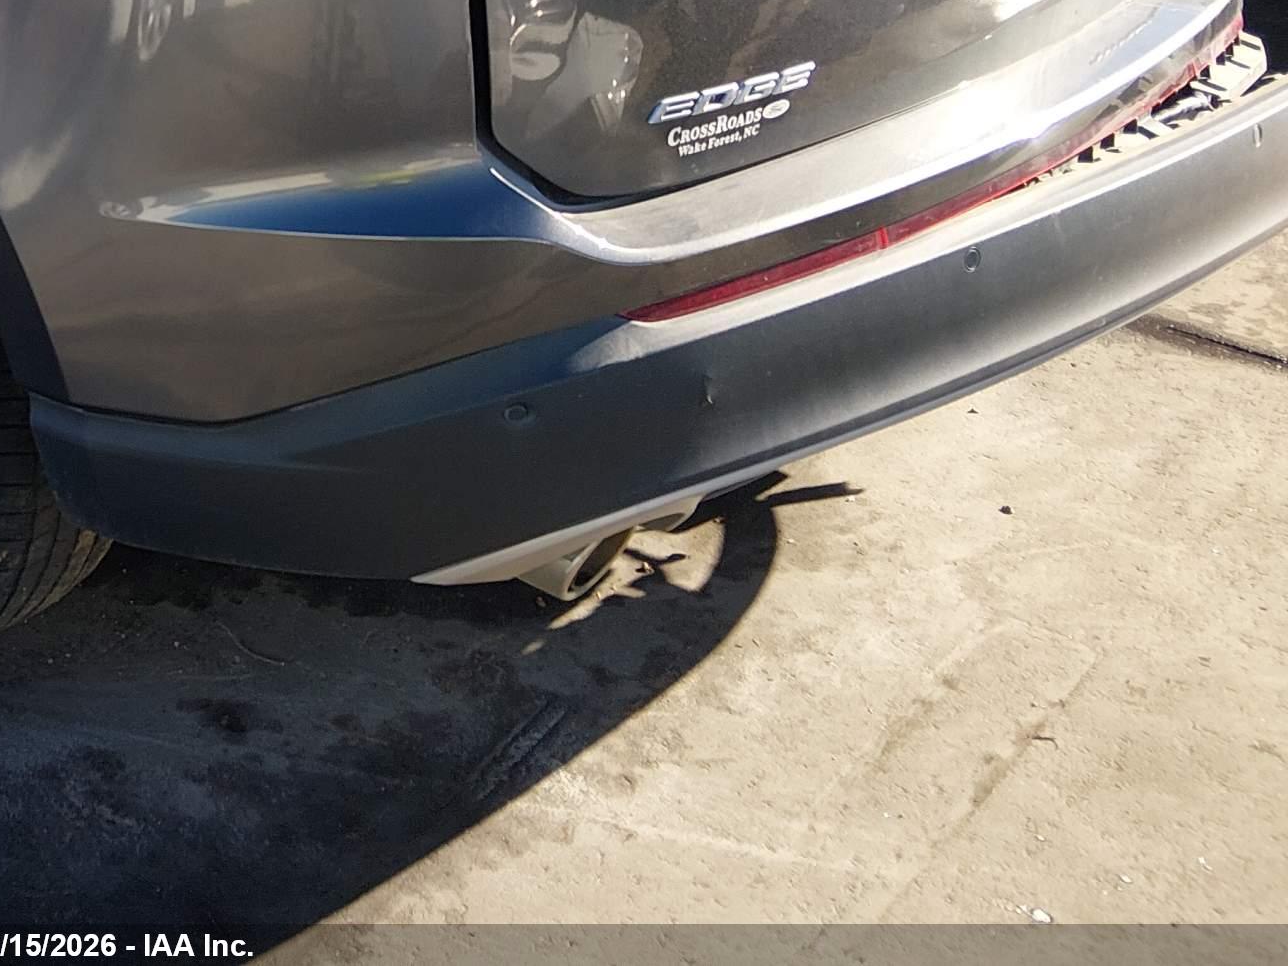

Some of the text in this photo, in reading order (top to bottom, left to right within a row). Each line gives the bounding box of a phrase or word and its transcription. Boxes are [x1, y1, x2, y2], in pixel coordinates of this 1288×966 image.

[648, 60, 816, 124] EDGE
[678, 123, 761, 158] Wake Forest, NC
